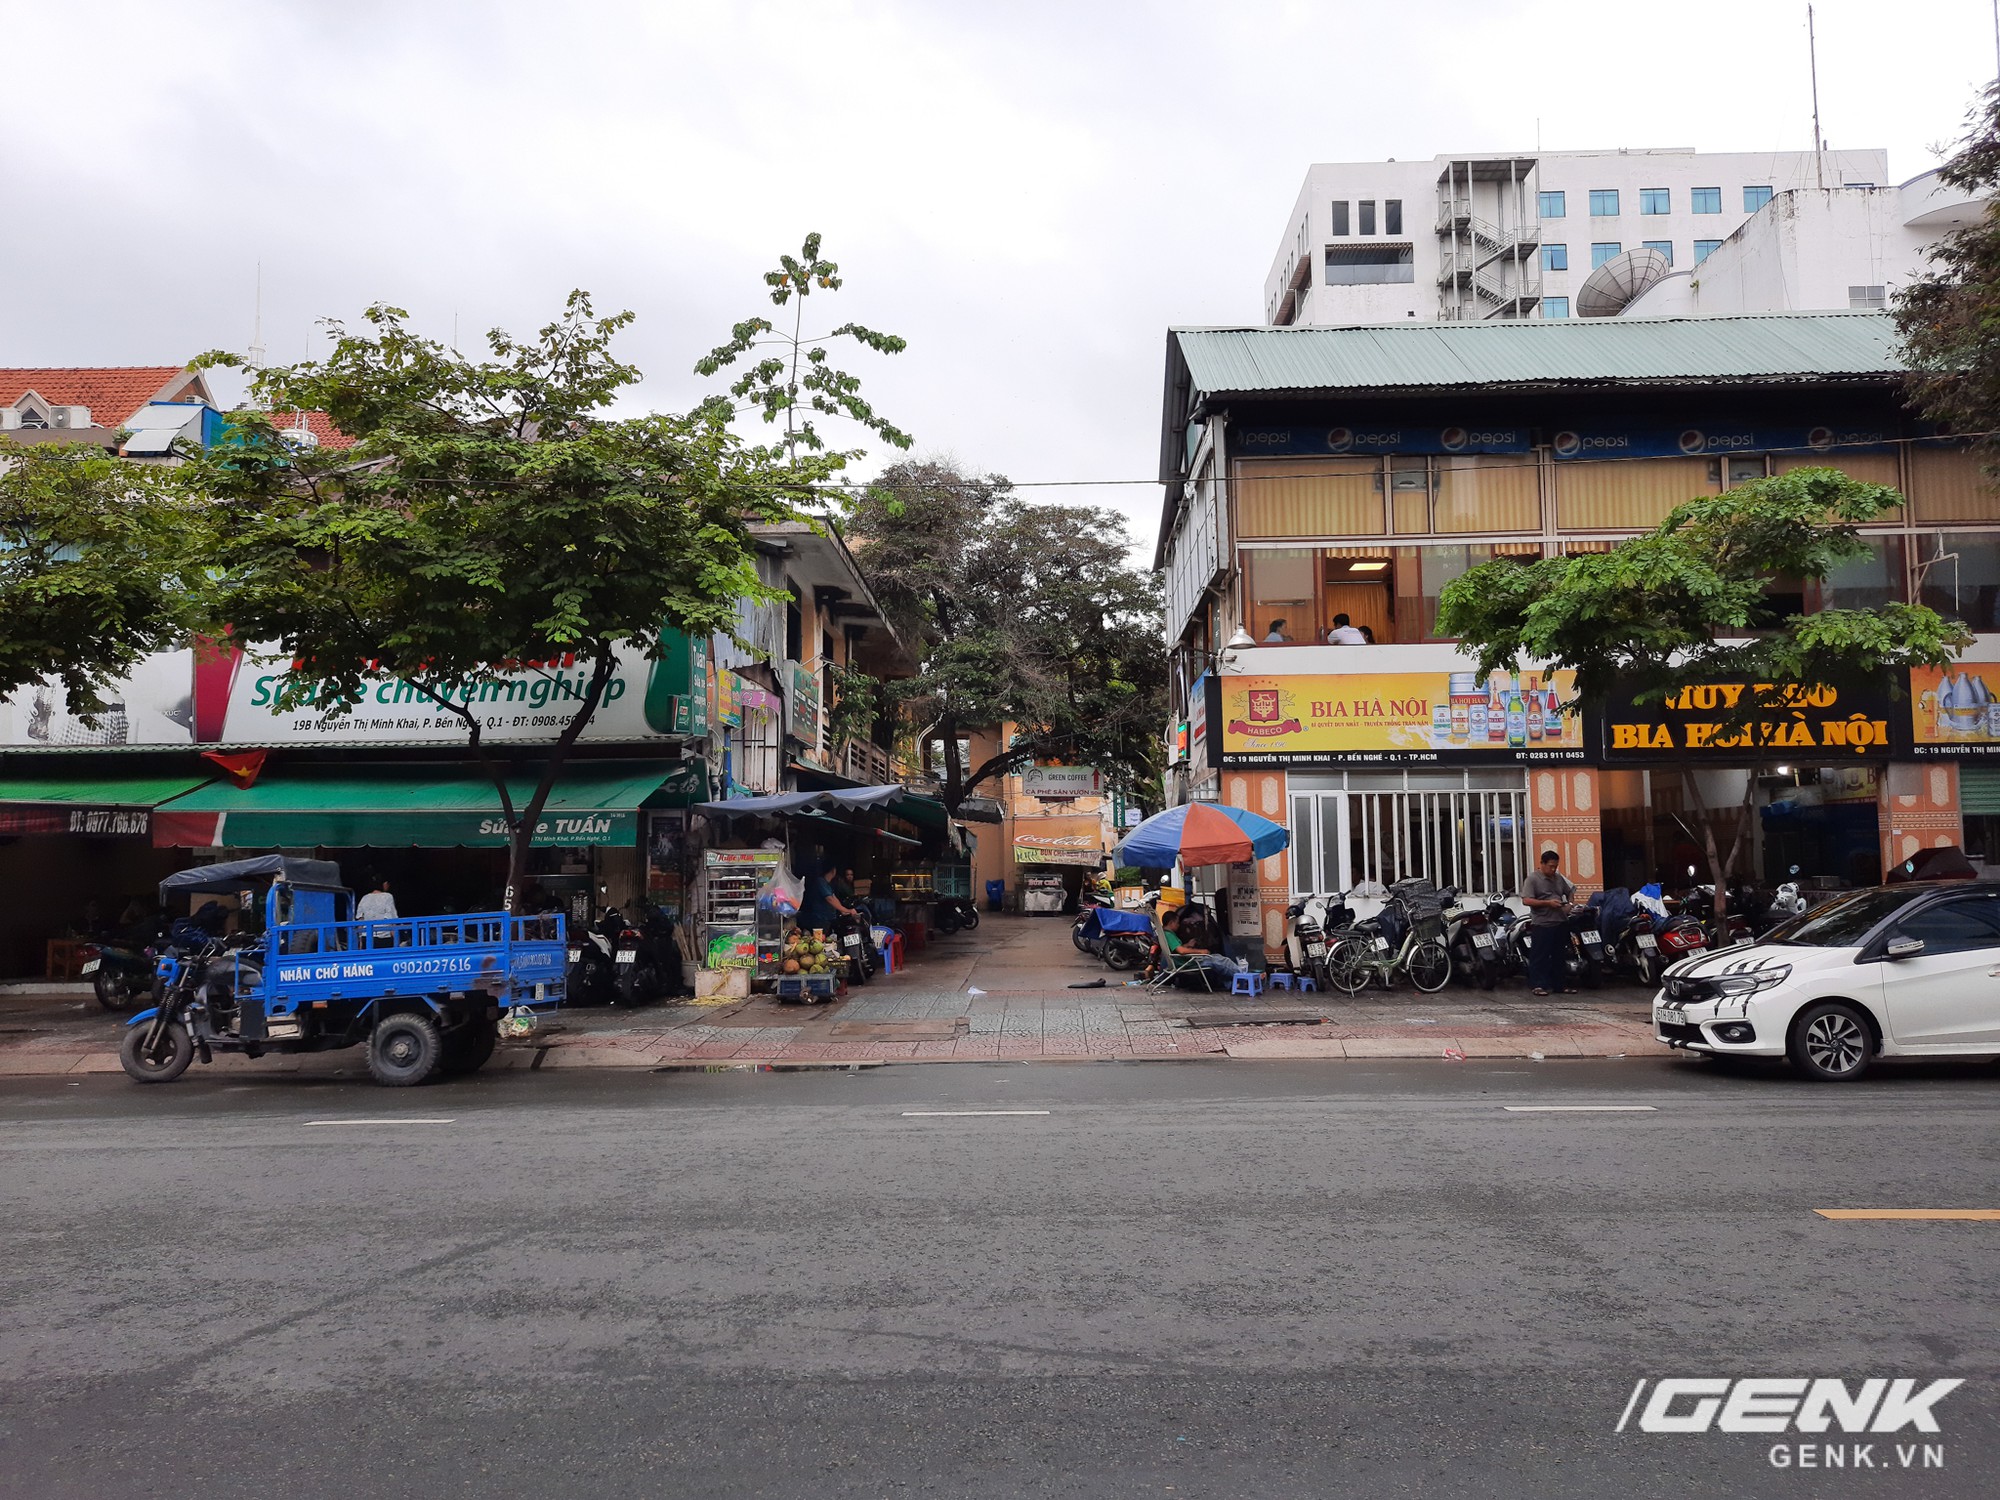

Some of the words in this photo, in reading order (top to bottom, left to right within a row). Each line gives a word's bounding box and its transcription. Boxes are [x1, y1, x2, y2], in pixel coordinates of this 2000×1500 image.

[1245, 430, 1291, 447] pepsi
[1355, 431, 1401, 447] pepsi
[1469, 431, 1516, 447] pepsi
[1582, 434, 1628, 450] pepsi
[1706, 433, 1754, 449] pepsi
[1836, 432, 1883, 446] pepsi
[506, 670, 626, 709] nghip
[1310, 701, 1348, 718] BIA
[1353, 697, 1386, 717] HÀ
[1390, 697, 1428, 718] NỘI
[292, 719, 311, 731] 19B
[315, 716, 350, 733] Nguyễn
[353, 719, 367, 732] Thị
[371, 719, 393, 730] Minh
[396, 718, 420, 731] Khai,
[423, 718, 432, 729] P.
[435, 714, 450, 729] Bến
[486, 715, 503, 729] Q.1
[512, 715, 529, 727] ĐT:
[1247, 726, 1283, 736] HABECO
[1611, 723, 1675, 749] BIA
[1821, 712, 1889, 754] NỘI
[1223, 755, 1236, 763] ĐC:
[1238, 755, 1247, 763] 19
[1248, 753, 1277, 763] NGUYỄN
[1278, 755, 1291, 764] THỊ
[1347, 751, 1361, 762] BẾN
[1363, 752, 1383, 762] NGHÉ
[1389, 754, 1402, 762] Q.1
[1409, 753, 1438, 761] TP.HCM
[1566, 751, 1585, 759] 0453
[1930, 746, 1939, 754] 19
[1941, 744, 1970, 754] NGUYỄN
[1972, 746, 1985, 755] THỊ
[1048, 773, 1066, 781] GREEN
[1067, 773, 1088, 781] COFFEE
[555, 813, 612, 834] TUẤN
[1015, 834, 1097, 846] Coca-Cola
[280, 967, 311, 983] NHẬN
[315, 963, 340, 980] CHỞ
[343, 963, 374, 979] HÀNG
[392, 957, 472, 974] 0902027616
